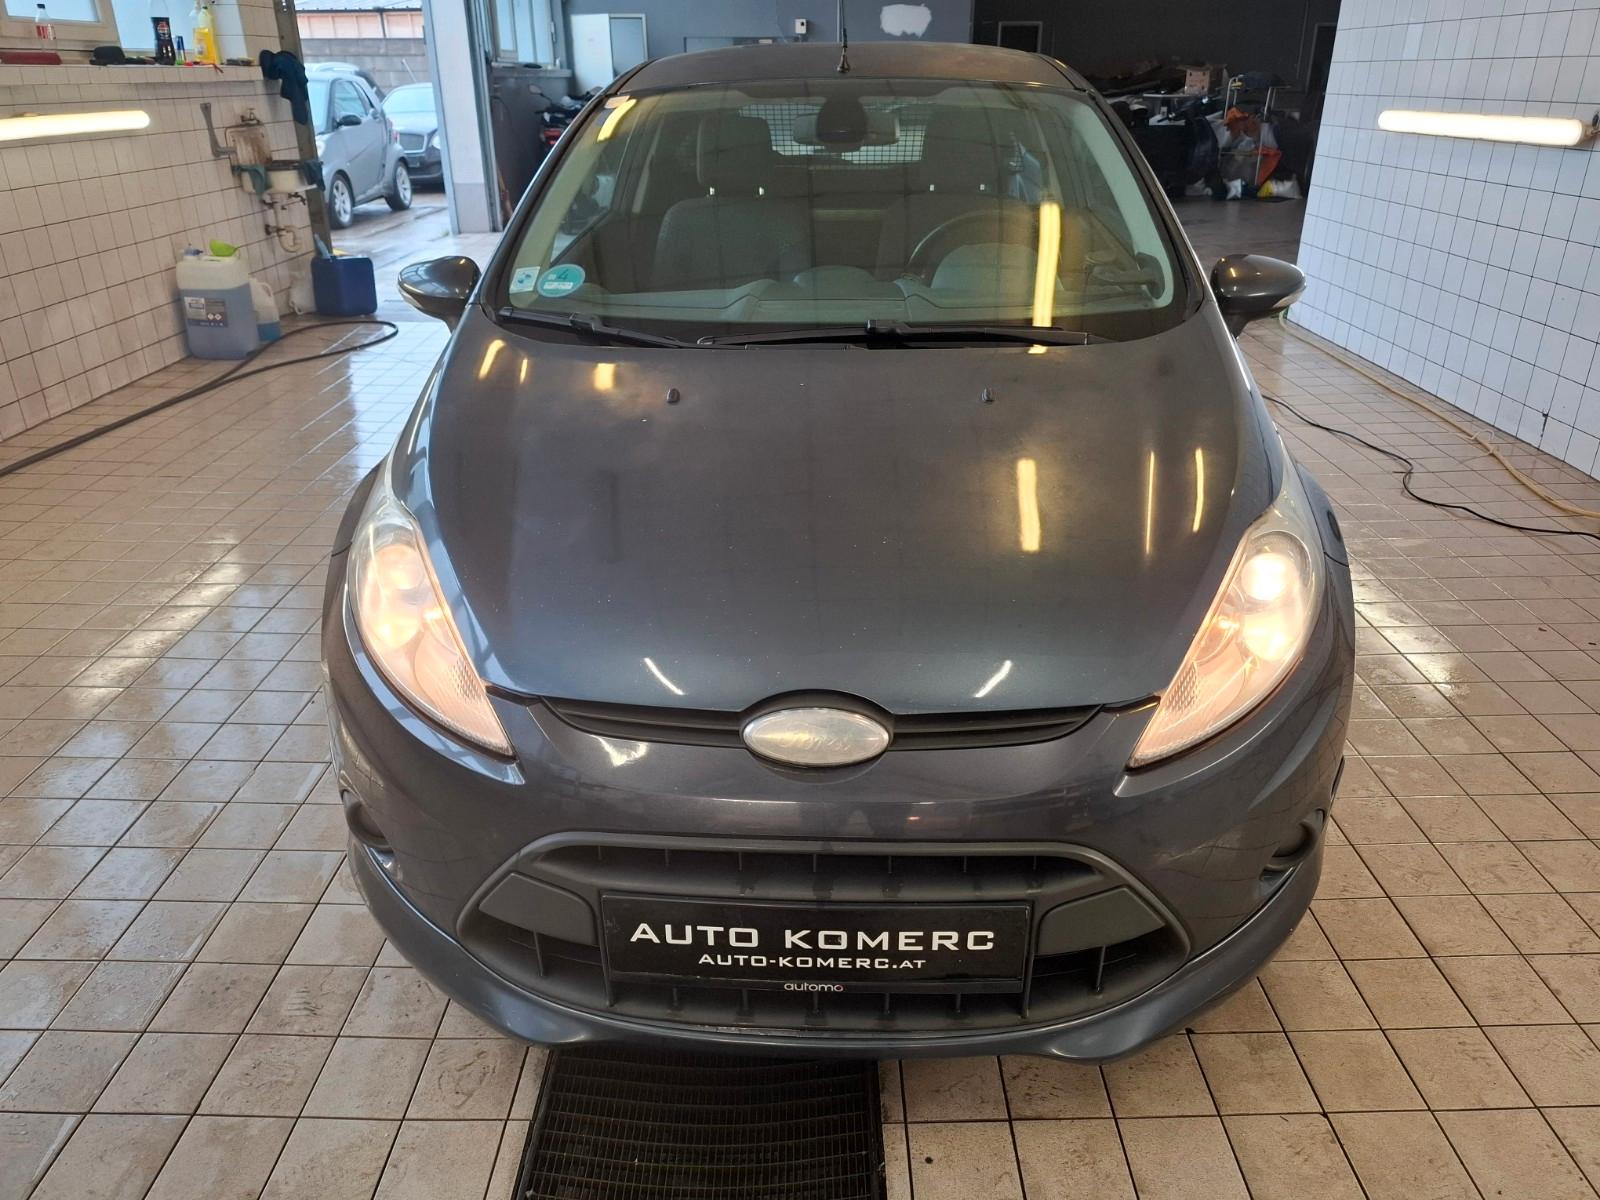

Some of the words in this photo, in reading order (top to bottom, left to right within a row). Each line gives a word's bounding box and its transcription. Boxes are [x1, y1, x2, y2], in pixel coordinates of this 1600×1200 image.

[557, 268, 569, 280] 4
[630, 922, 759, 948] AUTO
[784, 929, 995, 951] KOMERC
[698, 953, 926, 969] AUTO-KOMERC.AT
[784, 982, 844, 992] automo
